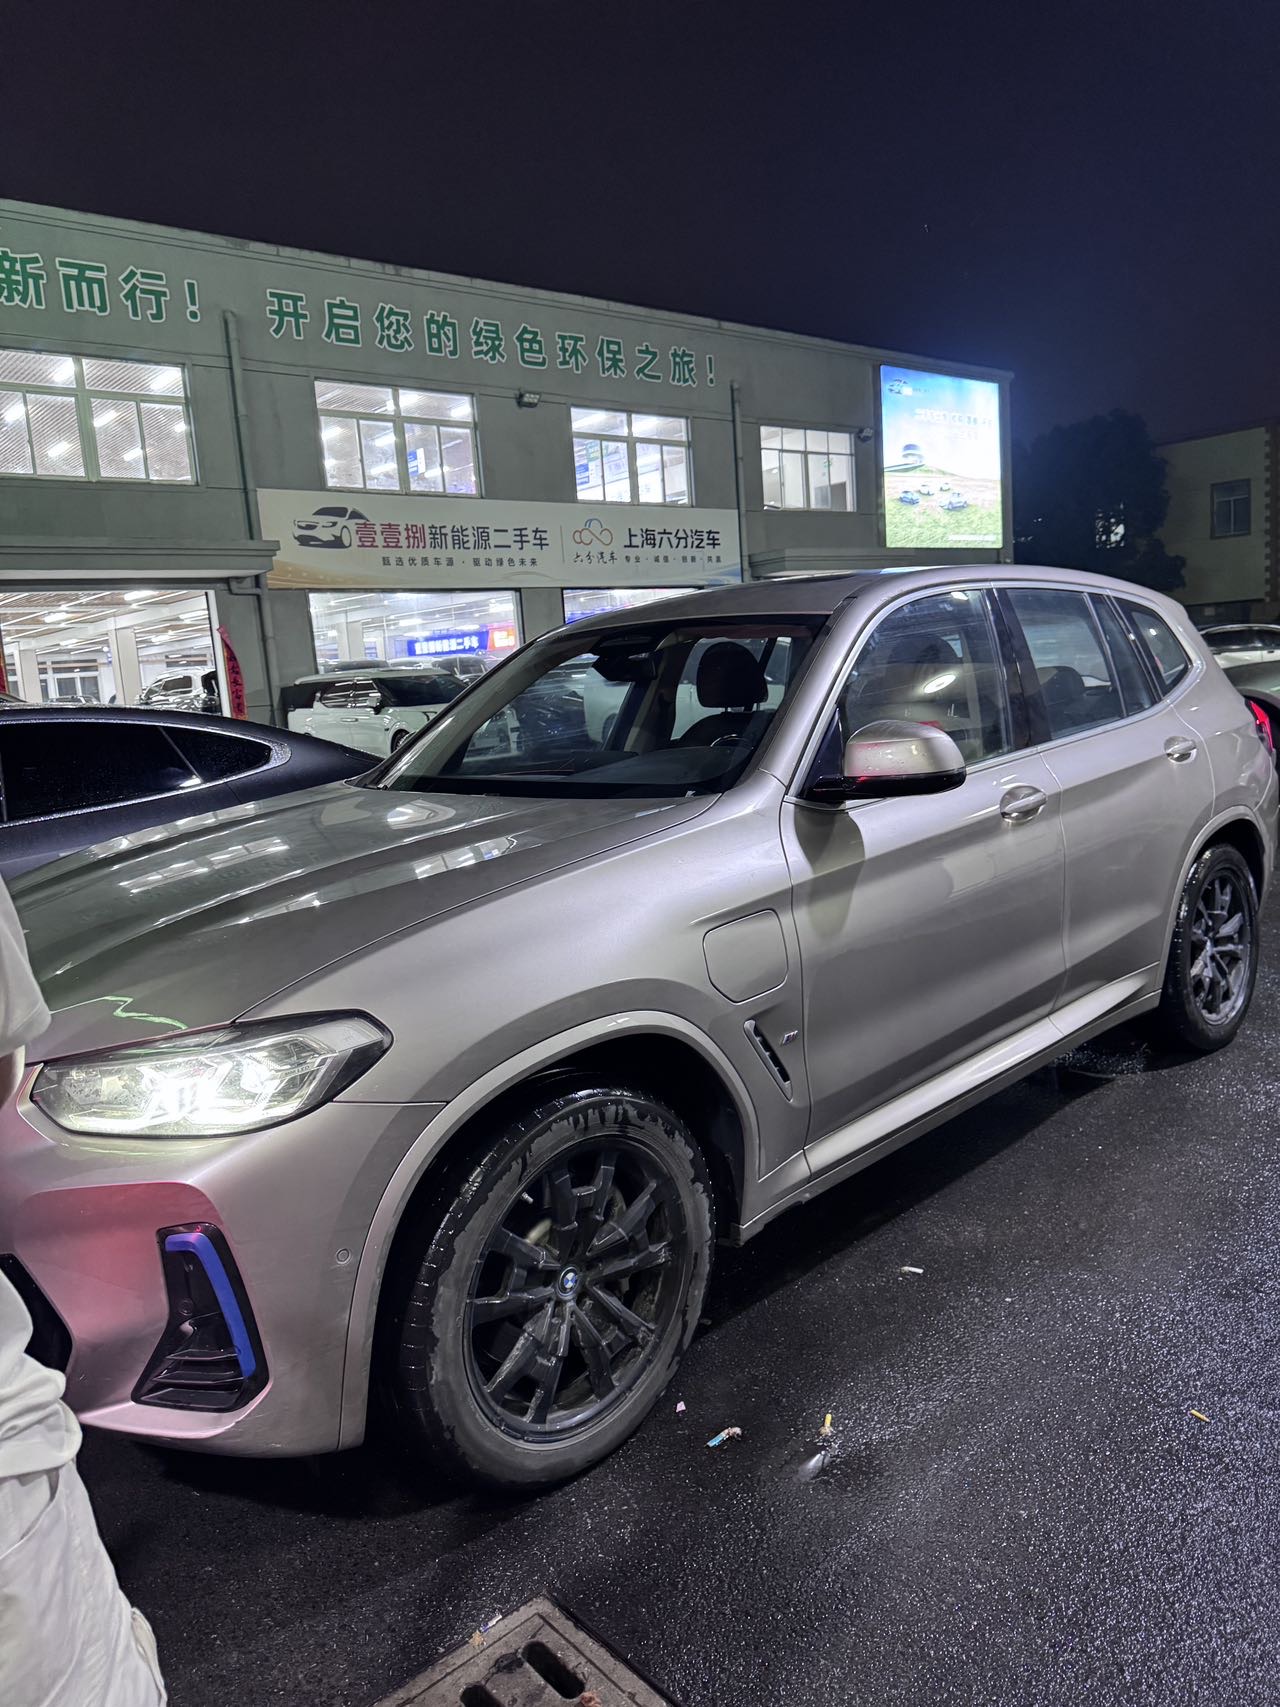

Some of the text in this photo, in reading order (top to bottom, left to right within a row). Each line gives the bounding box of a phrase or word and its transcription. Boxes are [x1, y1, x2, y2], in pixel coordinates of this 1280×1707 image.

[266, 289, 716, 387] 开启您的绿色环保之旅！
[355, 521, 549, 551] 壹壹捌新能源二手车
[624, 528, 721, 550] 上海六分汽车
[573, 551, 618, 564] 六分汽车
